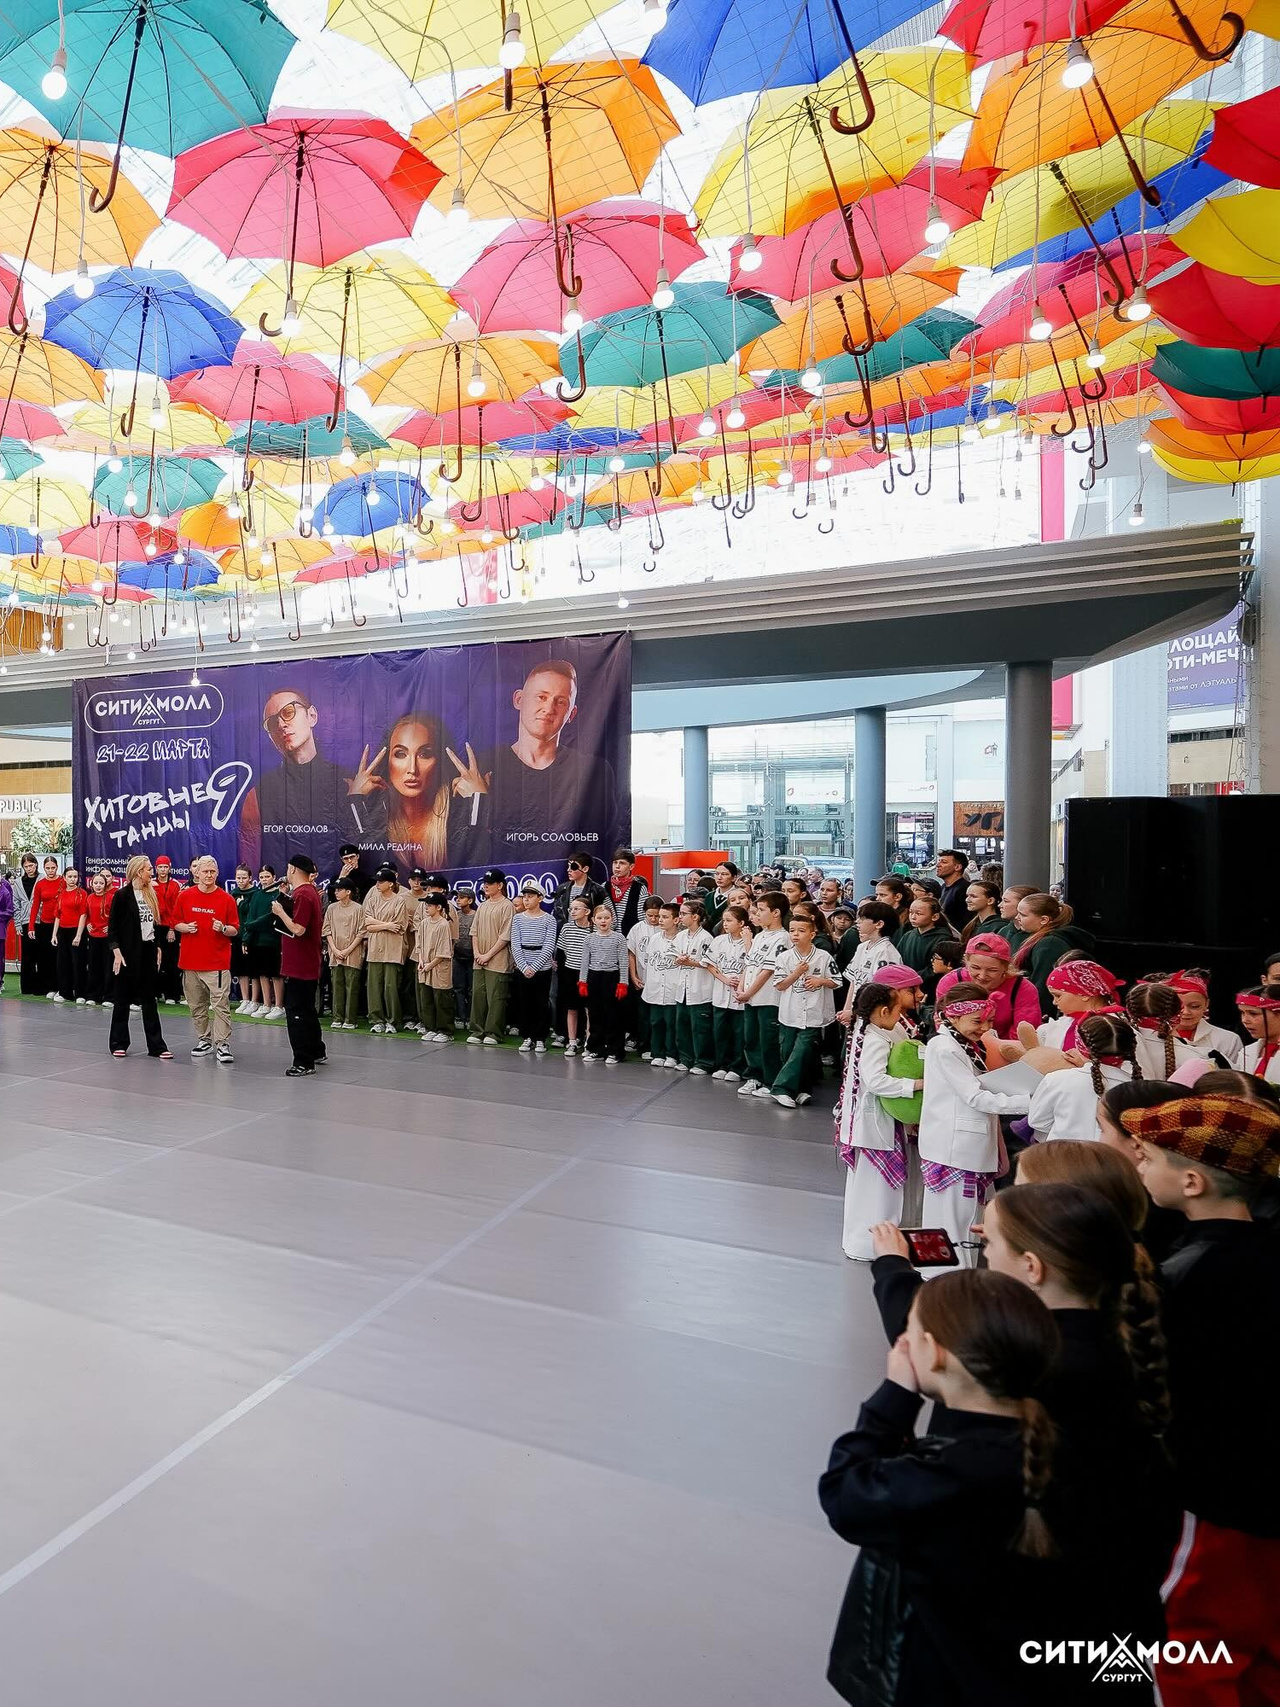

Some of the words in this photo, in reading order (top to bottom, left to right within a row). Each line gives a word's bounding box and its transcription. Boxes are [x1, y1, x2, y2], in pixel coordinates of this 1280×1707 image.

[1167, 625, 1241, 654] ЛОЩАЙ
[137, 717, 161, 726] СУРГУТ
[96, 743, 150, 764] 21-22
[152, 737, 211, 761] МАРТА
[84, 782, 210, 832] ХИТОВЫЕ
[110, 810, 191, 849] ТАНЦЫ
[263, 825, 284, 834] ЕГОР
[285, 824, 329, 834] СОКОЛОВ
[506, 832, 539, 843] ИГОРЬ
[541, 832, 599, 842] СОЛОВЬЕВ
[358, 843, 385, 852] МИЛА
[387, 842, 423, 852] РЕДИНА
